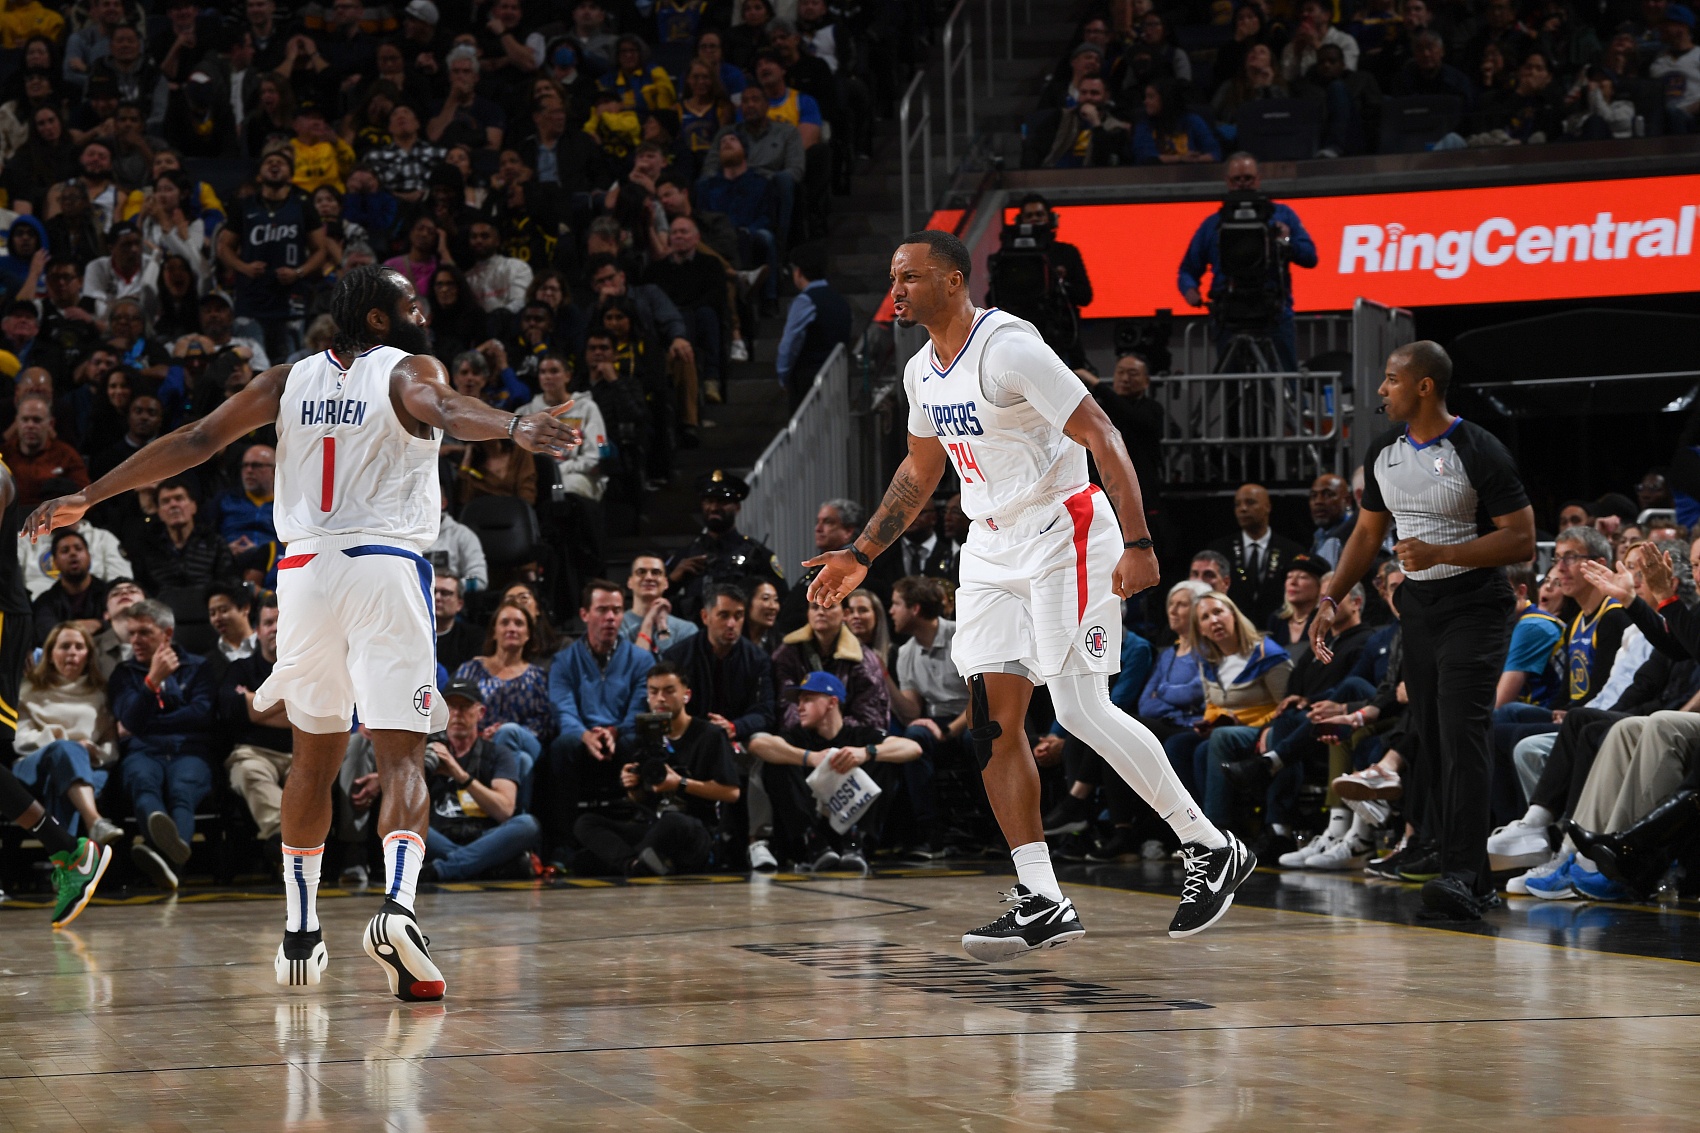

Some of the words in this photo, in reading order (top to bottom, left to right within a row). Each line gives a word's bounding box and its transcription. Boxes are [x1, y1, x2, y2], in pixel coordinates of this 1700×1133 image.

[249, 223, 298, 246] Clips
[1338, 205, 1696, 280] RingCentral
[320, 436, 336, 513] 1
[947, 441, 986, 484] 24
